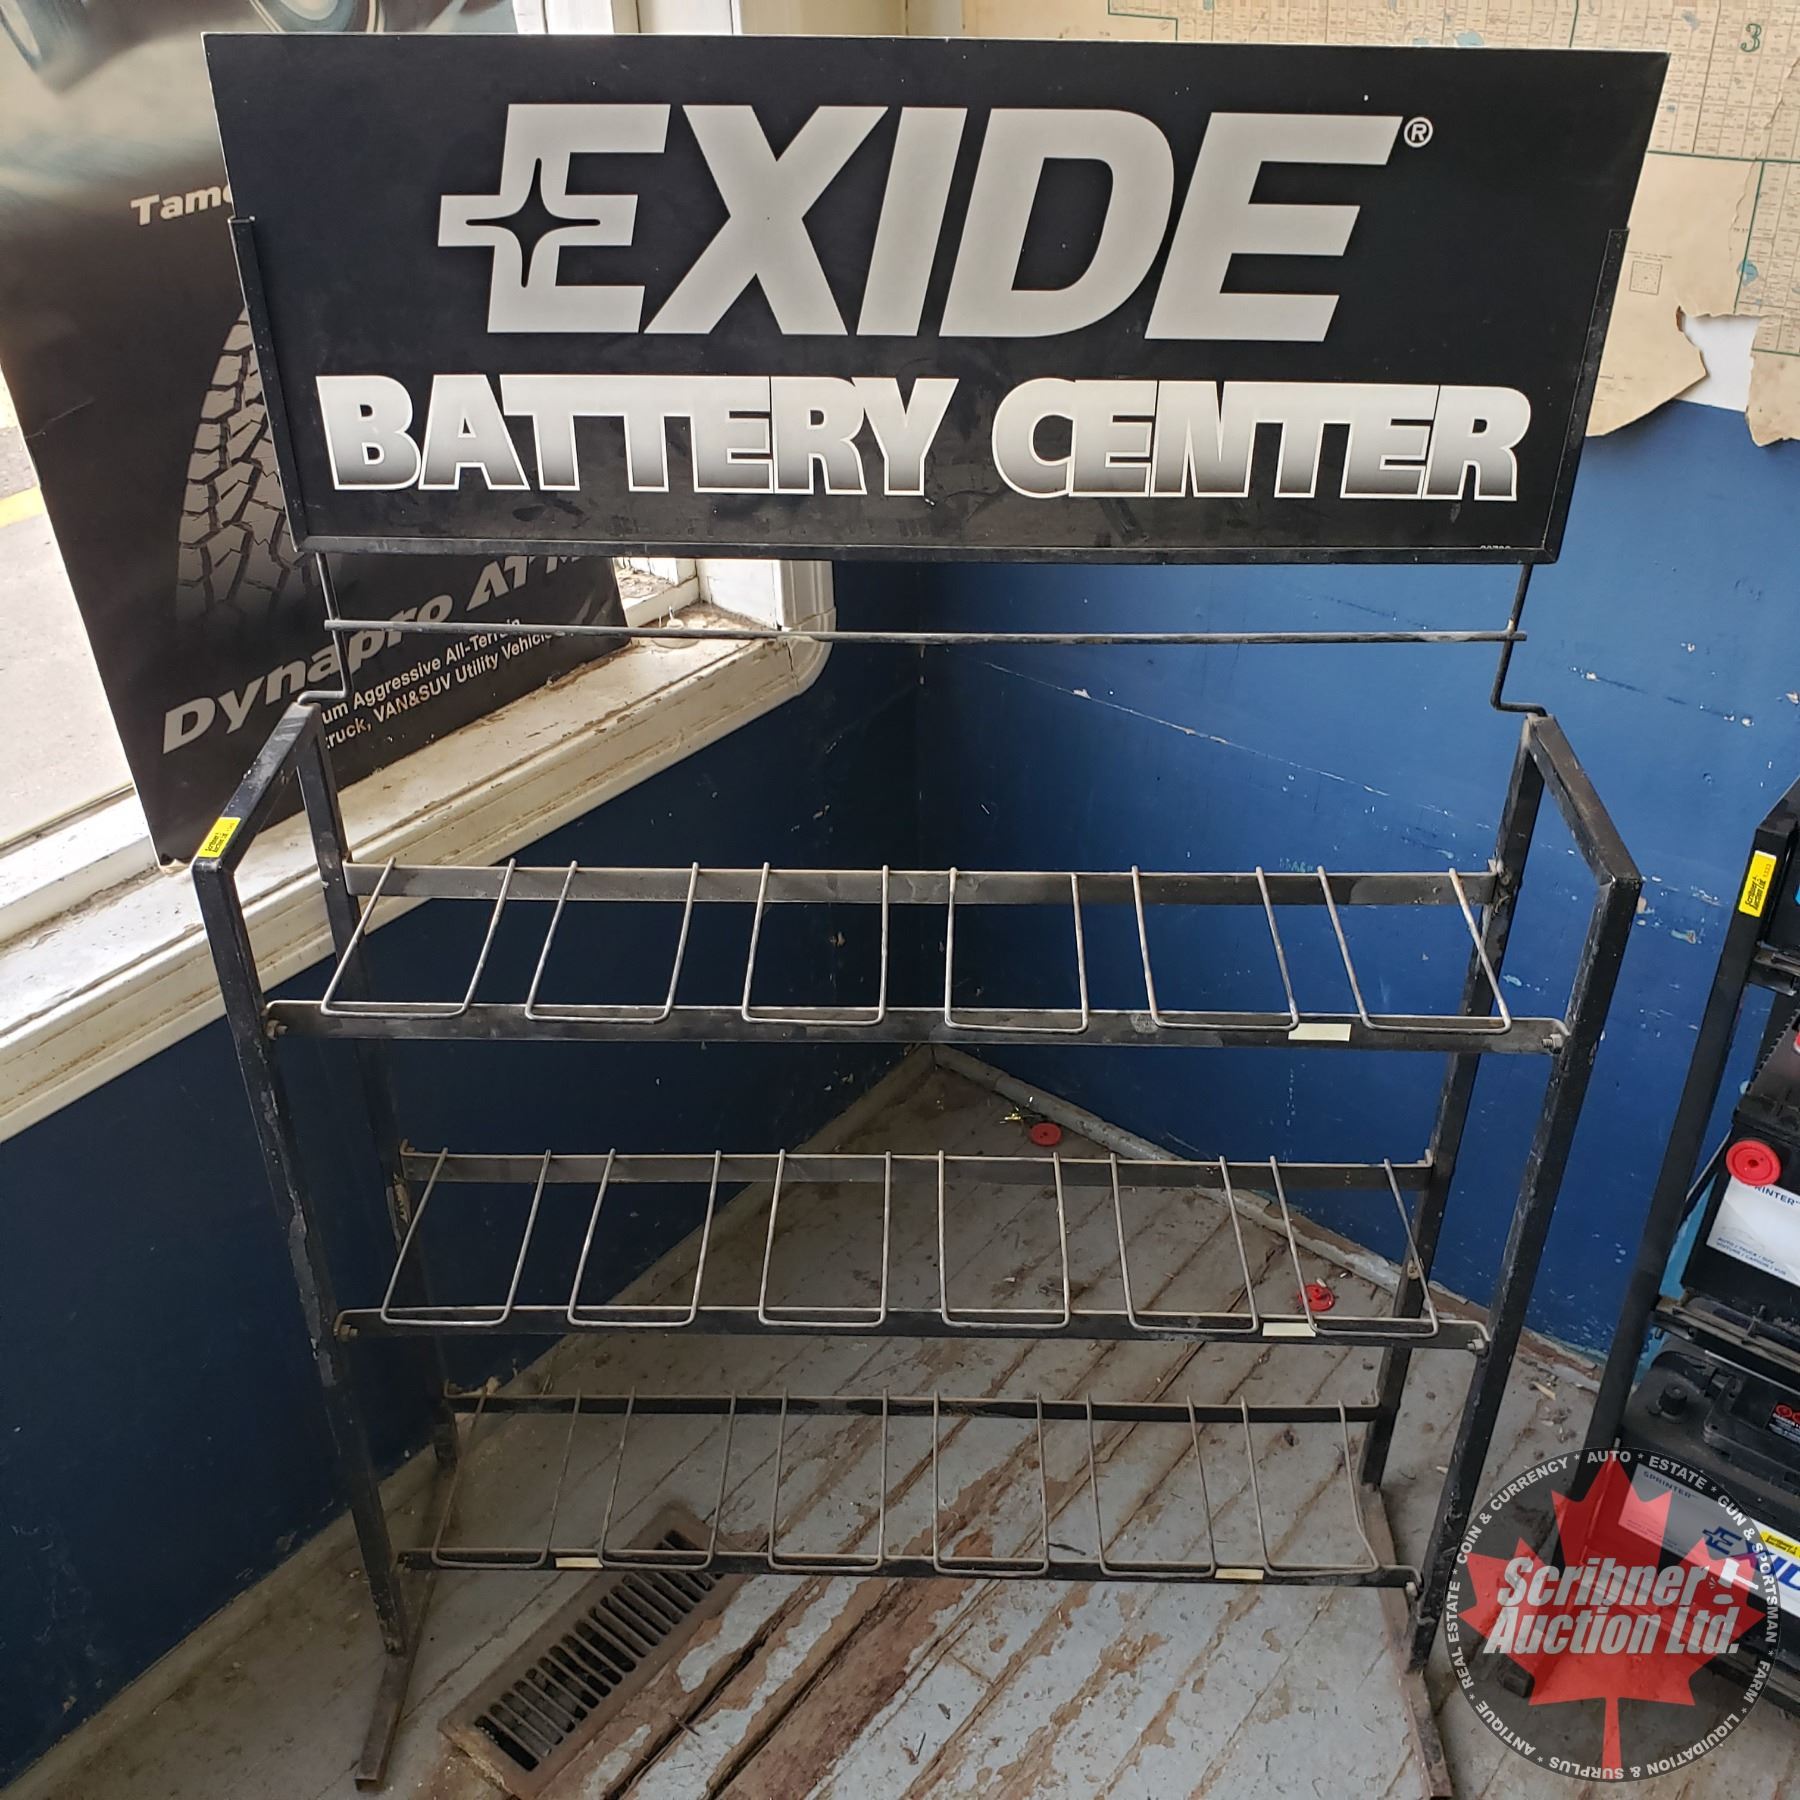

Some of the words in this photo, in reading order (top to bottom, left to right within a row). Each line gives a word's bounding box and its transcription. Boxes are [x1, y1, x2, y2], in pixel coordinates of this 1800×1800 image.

[1740, 23, 1762, 52] 3
[315, 373, 959, 495] BATTERY
[991, 377, 1532, 502] CENTER
[162, 594, 453, 754] Dynapro
[353, 657, 442, 711] Aggressive
[445, 617, 521, 666] All-Terrn
[373, 673, 452, 724] VAN&SUV
[455, 653, 500, 684] Utility
